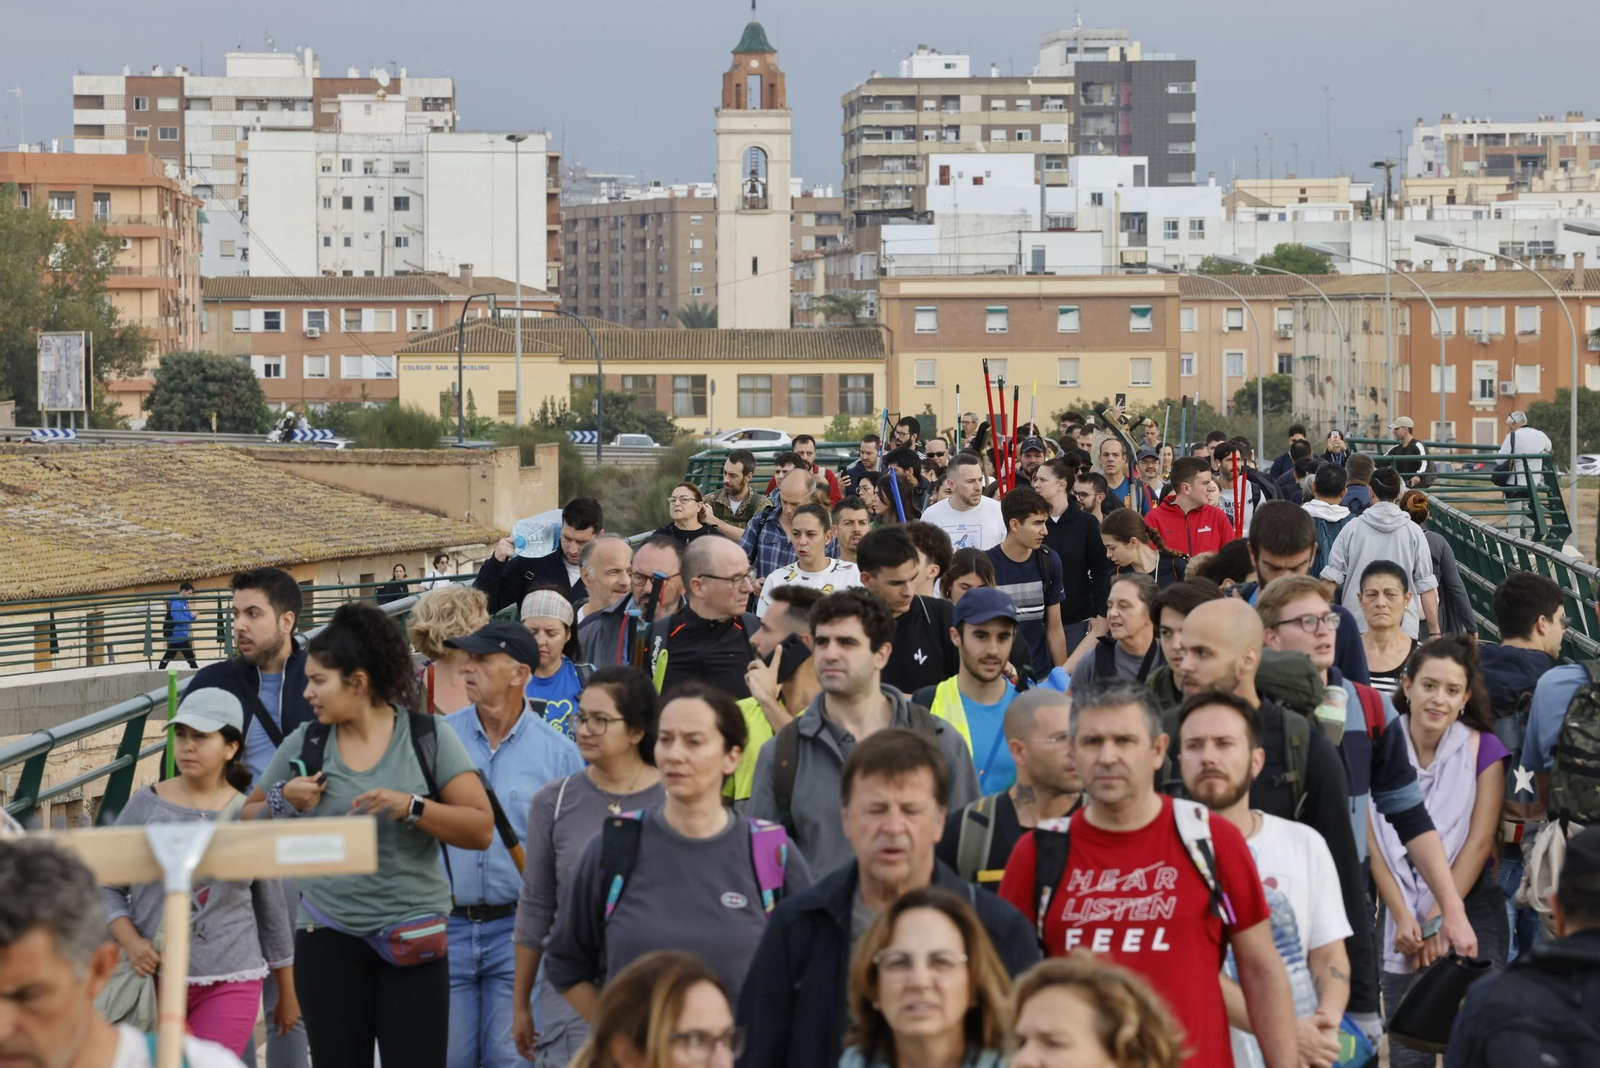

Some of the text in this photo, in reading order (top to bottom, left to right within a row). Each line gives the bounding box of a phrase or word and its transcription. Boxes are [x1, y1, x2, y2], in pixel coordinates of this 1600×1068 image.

[1067, 866, 1178, 892] HEAR
[1061, 896, 1177, 922] LISTEN
[1065, 927, 1170, 952] FEEL
